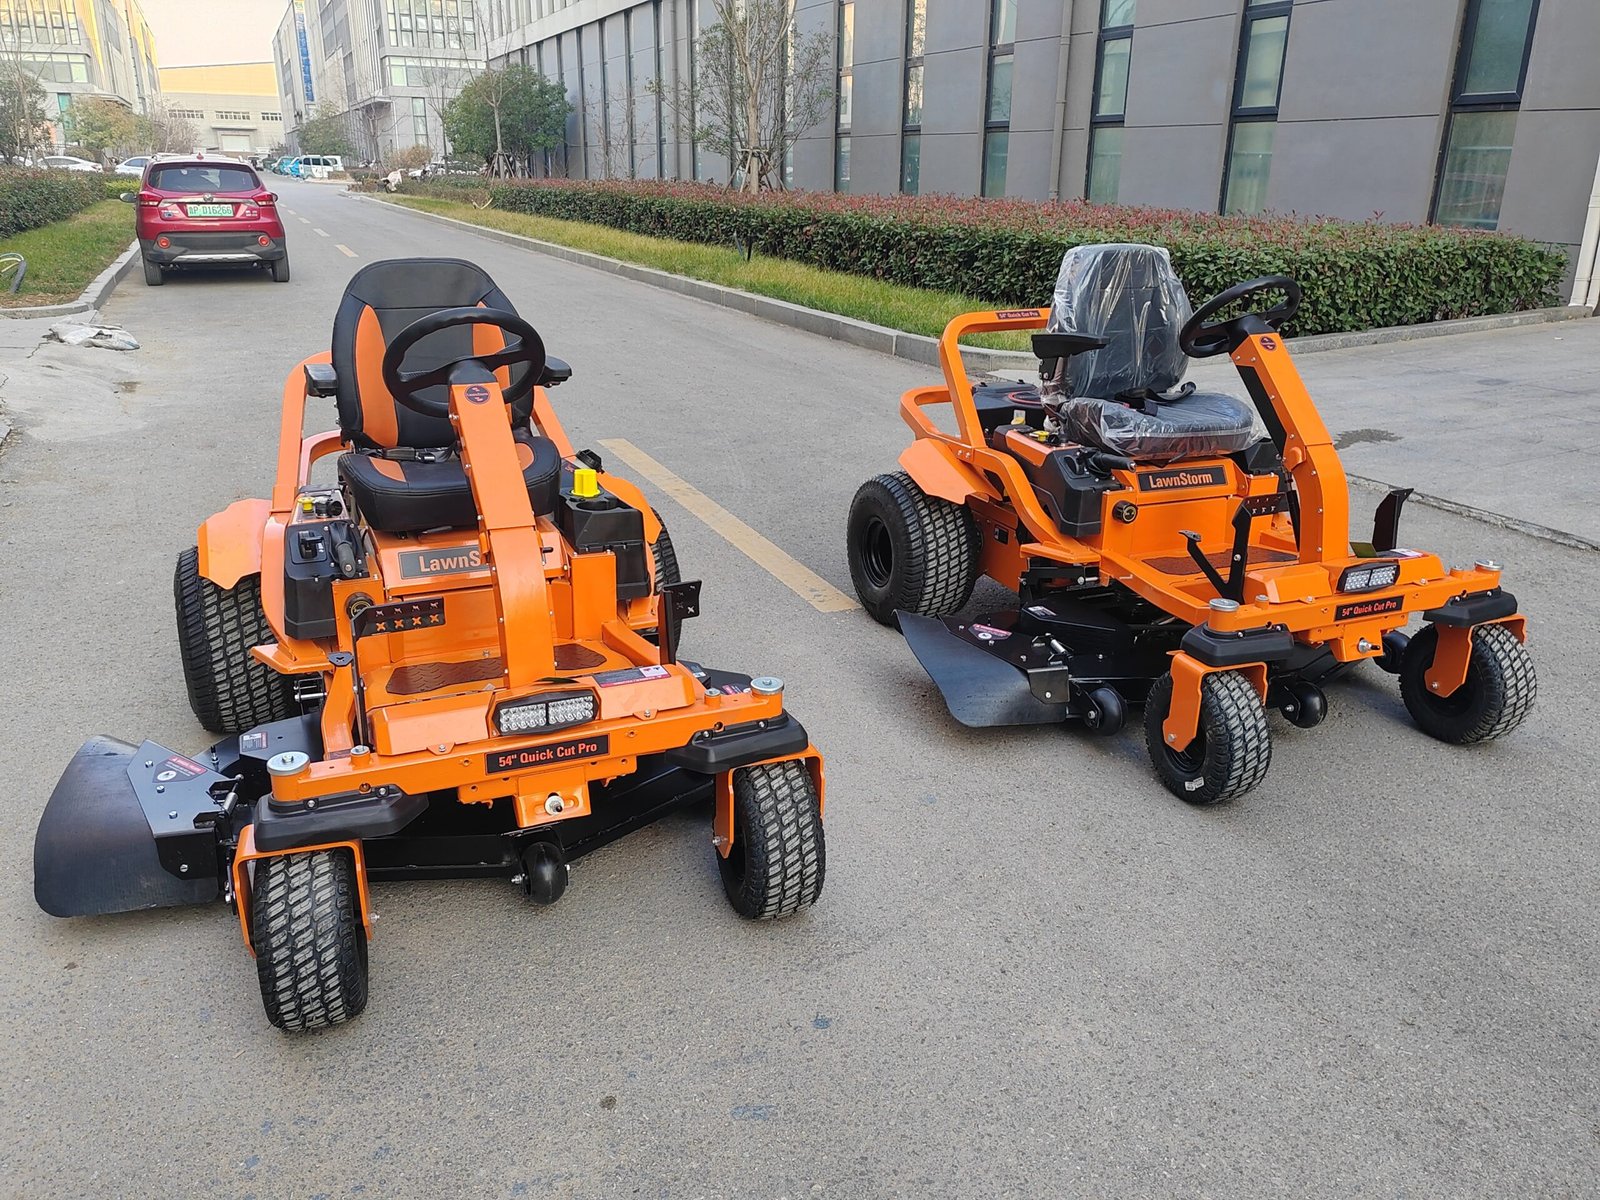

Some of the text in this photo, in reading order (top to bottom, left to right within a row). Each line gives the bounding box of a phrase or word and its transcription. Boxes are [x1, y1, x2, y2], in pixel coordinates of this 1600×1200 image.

[1149, 472, 1213, 488] LawnStorm
[1342, 600, 1397, 617] 54" Quick Cut Pro
[498, 742, 598, 768] 54" Quick Cut Pro
